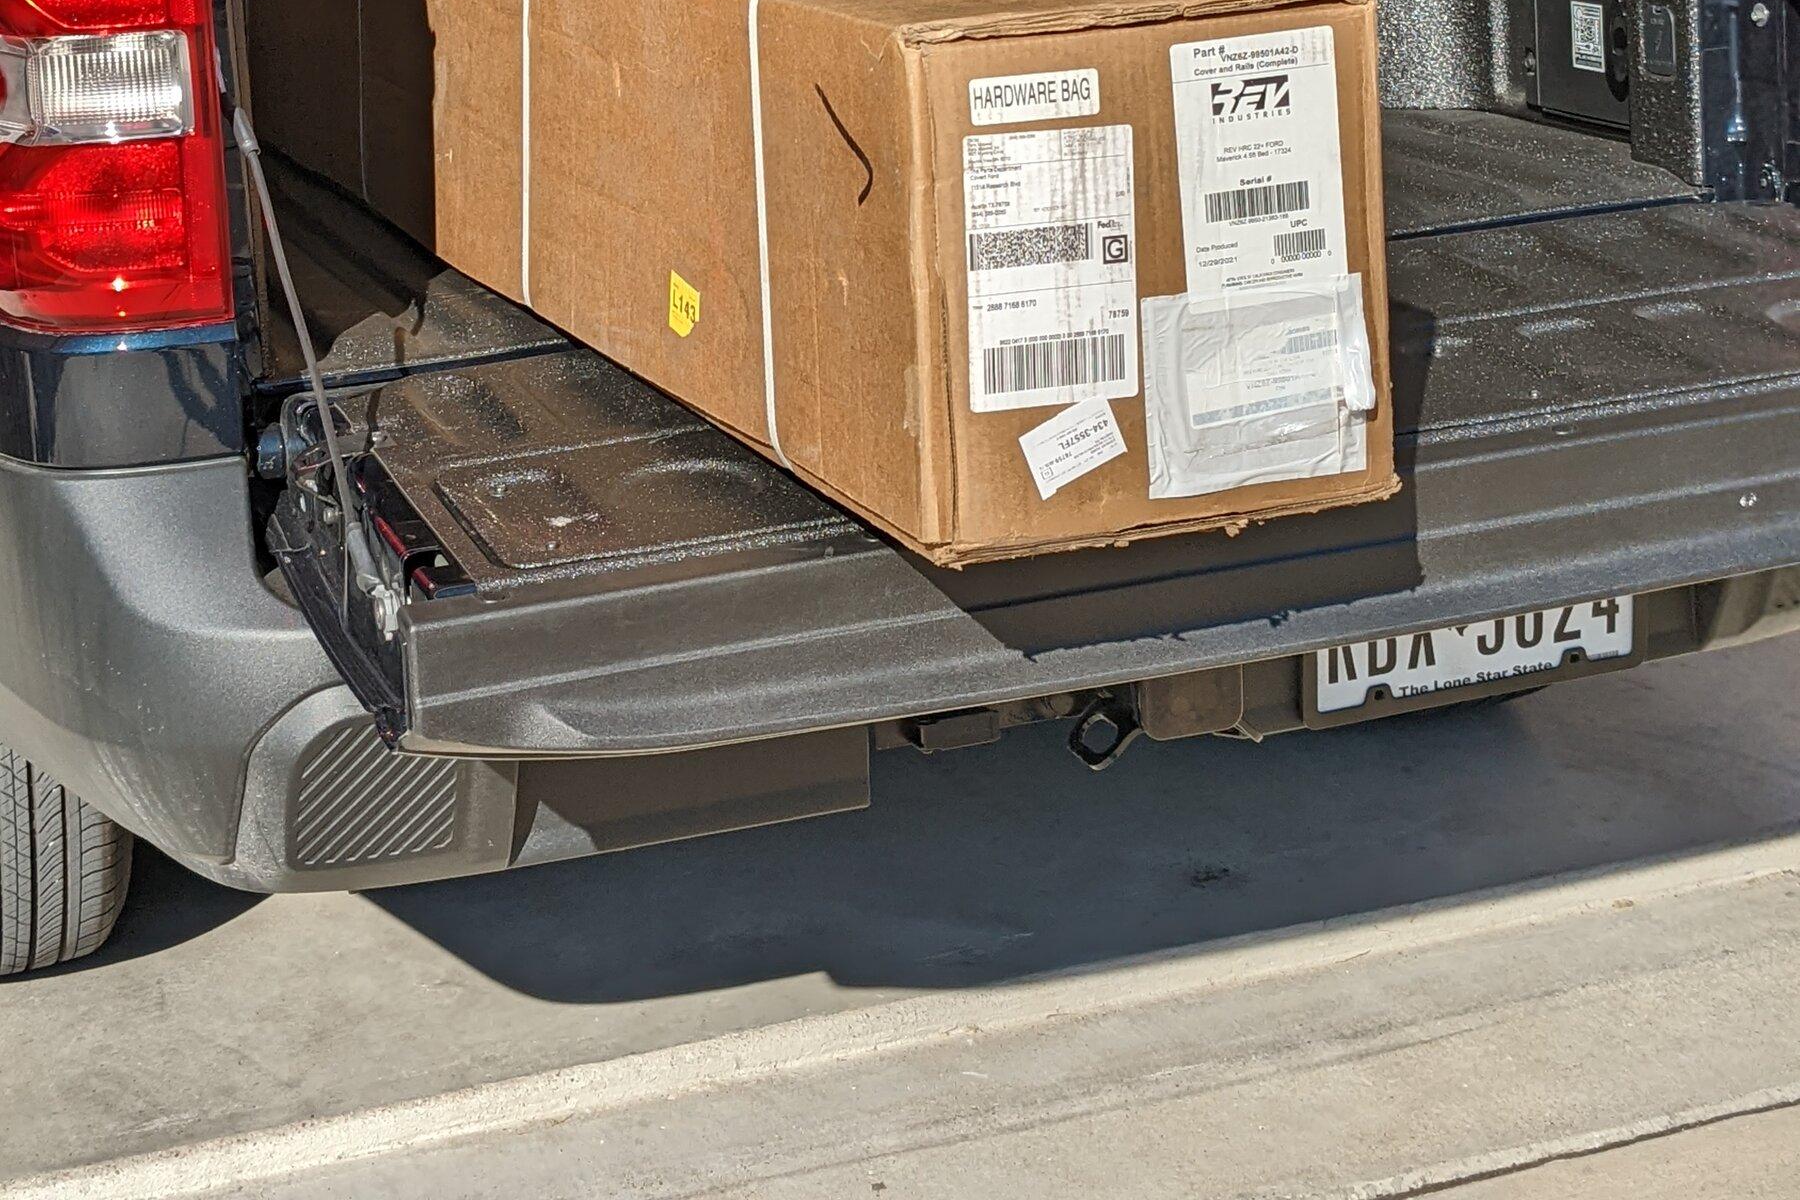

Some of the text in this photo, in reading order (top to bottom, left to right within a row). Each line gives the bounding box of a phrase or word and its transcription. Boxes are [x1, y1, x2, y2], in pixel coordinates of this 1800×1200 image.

[1193, 47, 1216, 58] Part
[1218, 45, 1226, 54] #
[1194, 57, 1298, 76] Cover and Rails (Complete)
[974, 78, 1091, 109] HARDWARE BAG
[1213, 108, 1291, 124] INDUSTRIES
[1266, 140, 1284, 148] FORD
[1240, 176, 1264, 186] Serial
[1290, 219, 1308, 228] UPC
[1107, 239, 1124, 259] G
[1211, 242, 1238, 251] Produced
[673, 288, 696, 323] L143
[1058, 419, 1109, 450] 434-3557FL
[1399, 661, 1552, 697] The Lone Star State
